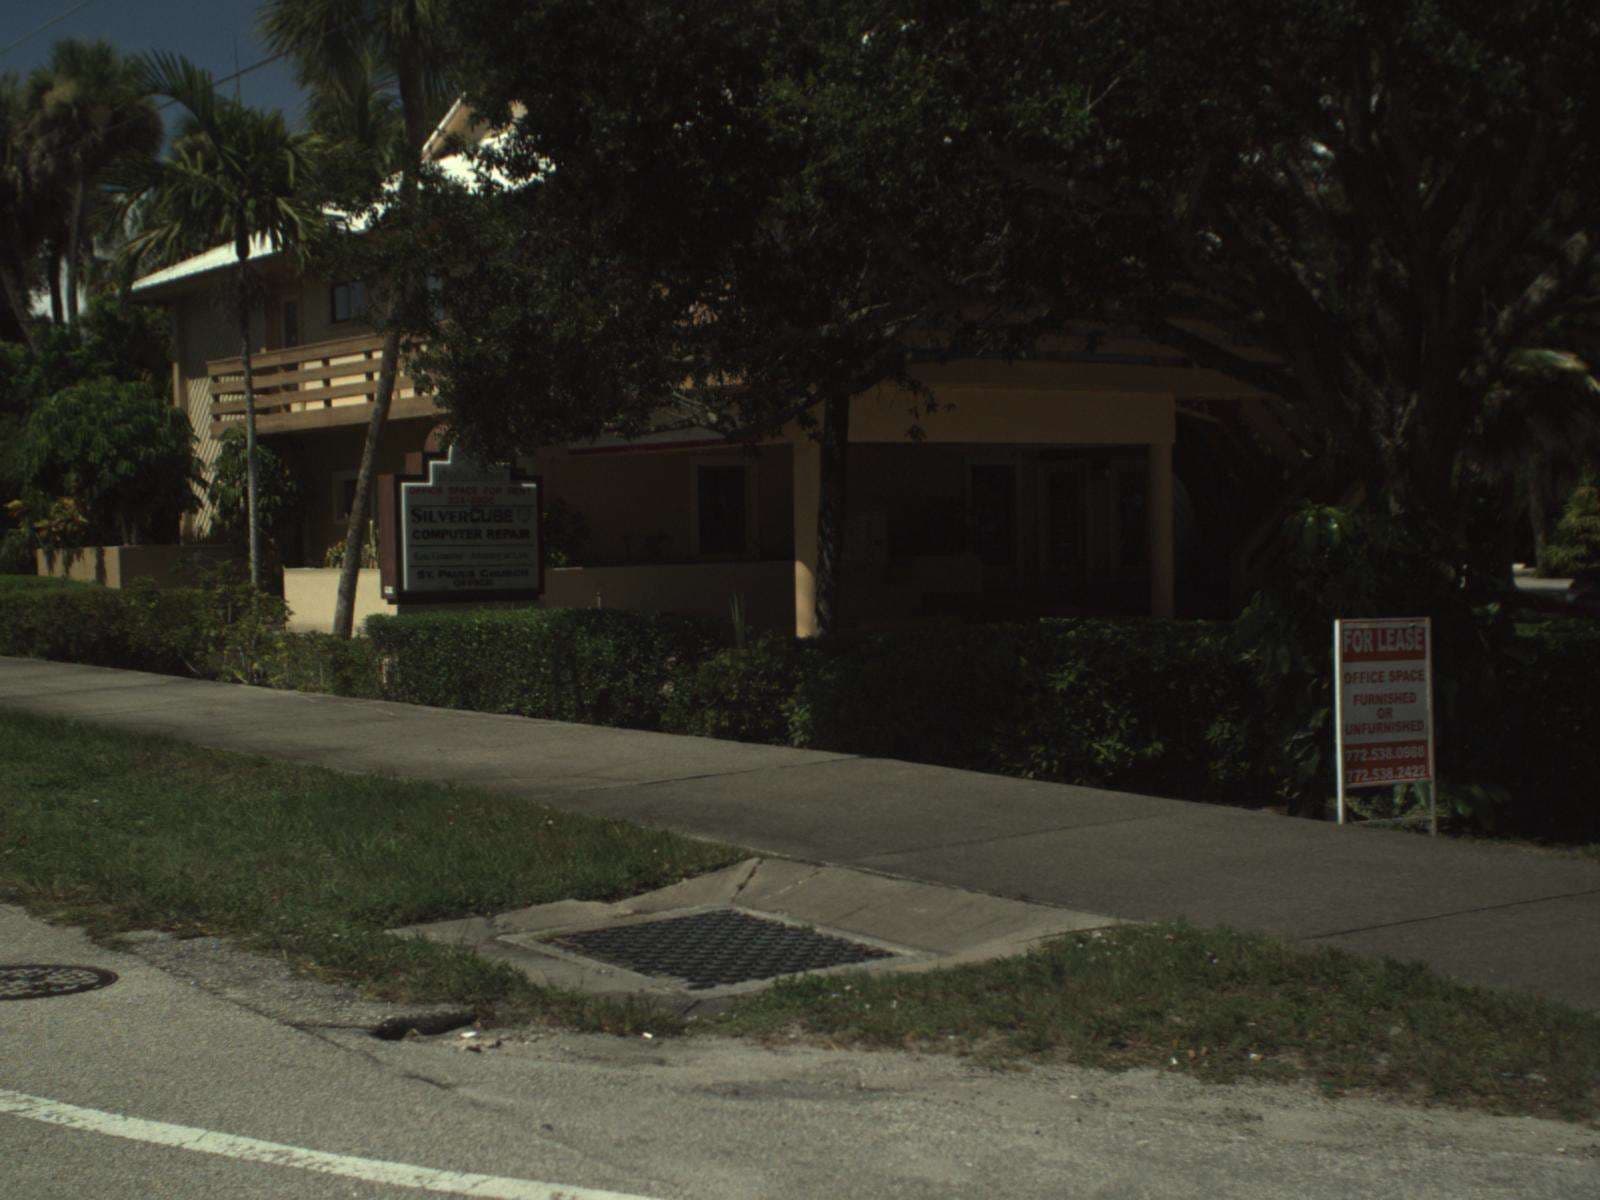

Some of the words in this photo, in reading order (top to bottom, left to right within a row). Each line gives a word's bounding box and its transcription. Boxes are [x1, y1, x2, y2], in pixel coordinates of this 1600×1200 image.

[412, 528, 482, 540] COMPUTER
[486, 528, 530, 540] REPAIR
[1343, 629, 1374, 653] FOR
[1377, 627, 1424, 652] LEASE
[1344, 671, 1385, 684] OFFICE
[1389, 669, 1425, 682] SPACE
[1353, 692, 1416, 706] FURNISHED
[1376, 707, 1393, 719] OR
[1344, 720, 1425, 735] UNFURNISHED
